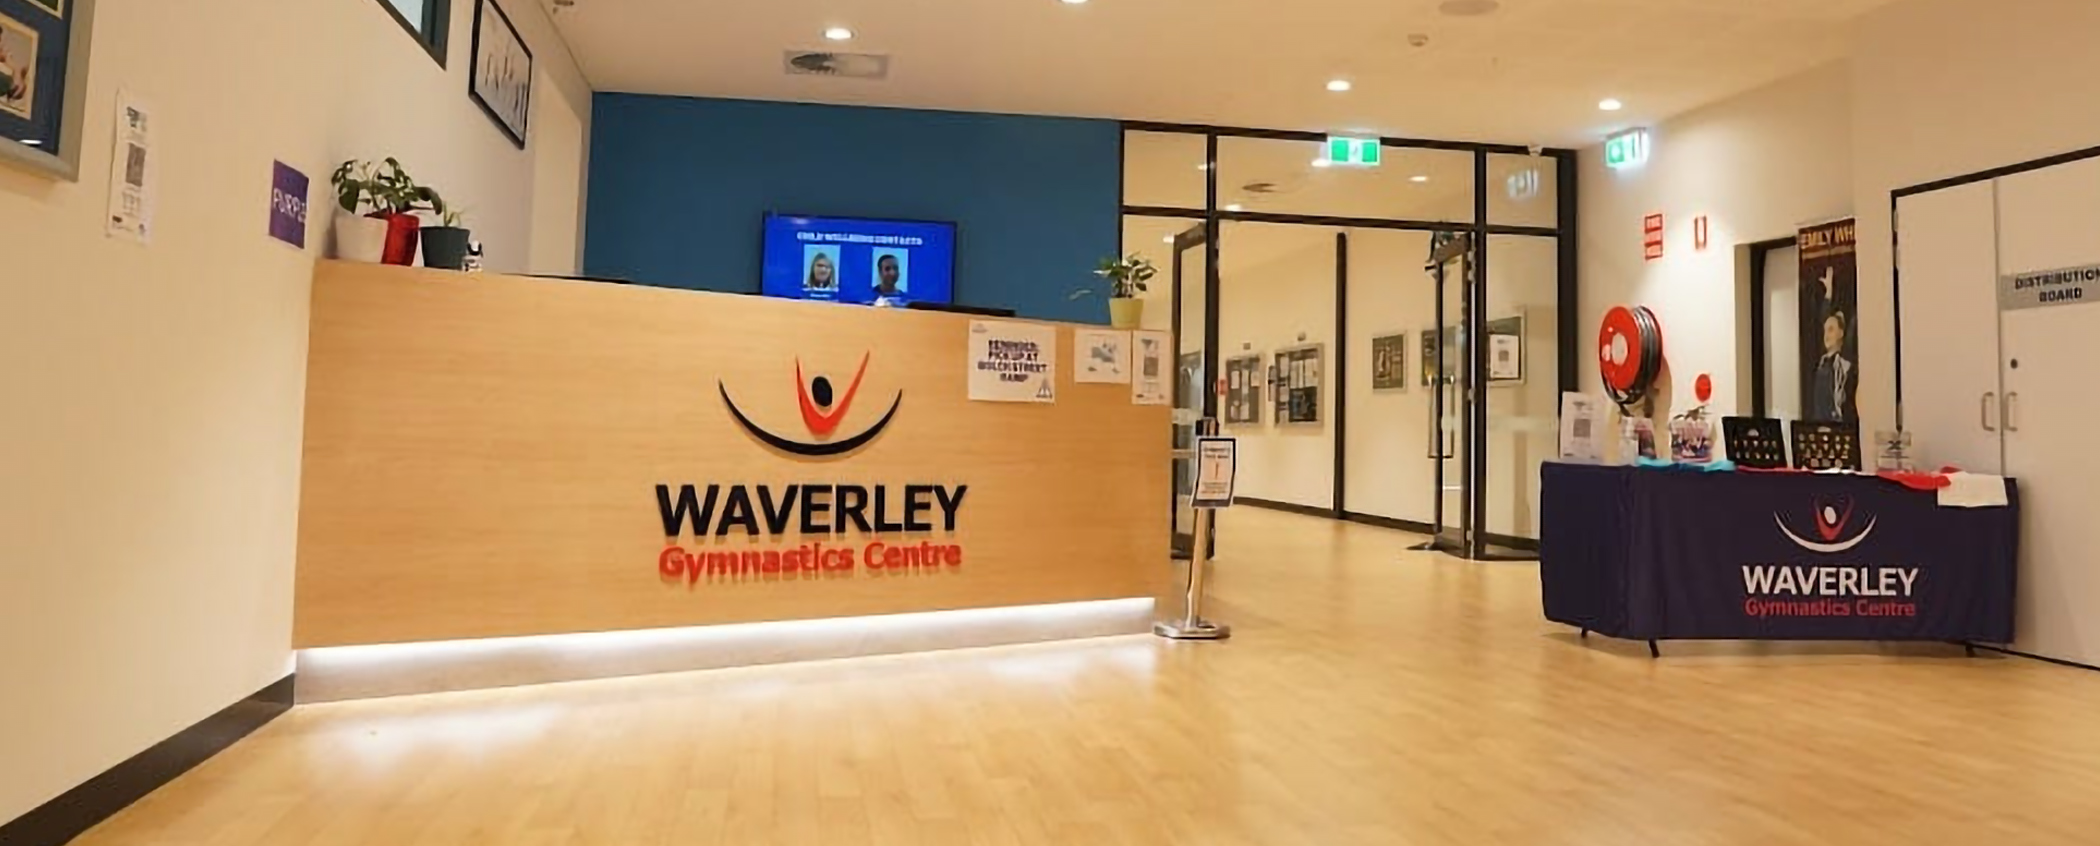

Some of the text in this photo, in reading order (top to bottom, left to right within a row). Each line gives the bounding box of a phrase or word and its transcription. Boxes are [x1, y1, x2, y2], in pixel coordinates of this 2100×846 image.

[1799, 229, 1834, 250] EMILY
[2039, 287, 2082, 302] BOARD
[655, 484, 968, 537] WAVERLEY
[658, 541, 963, 583] Gymnastics Centre
[1742, 565, 1919, 597] WAVERLEY
[1744, 598, 1916, 618] Gymnastics Centre
